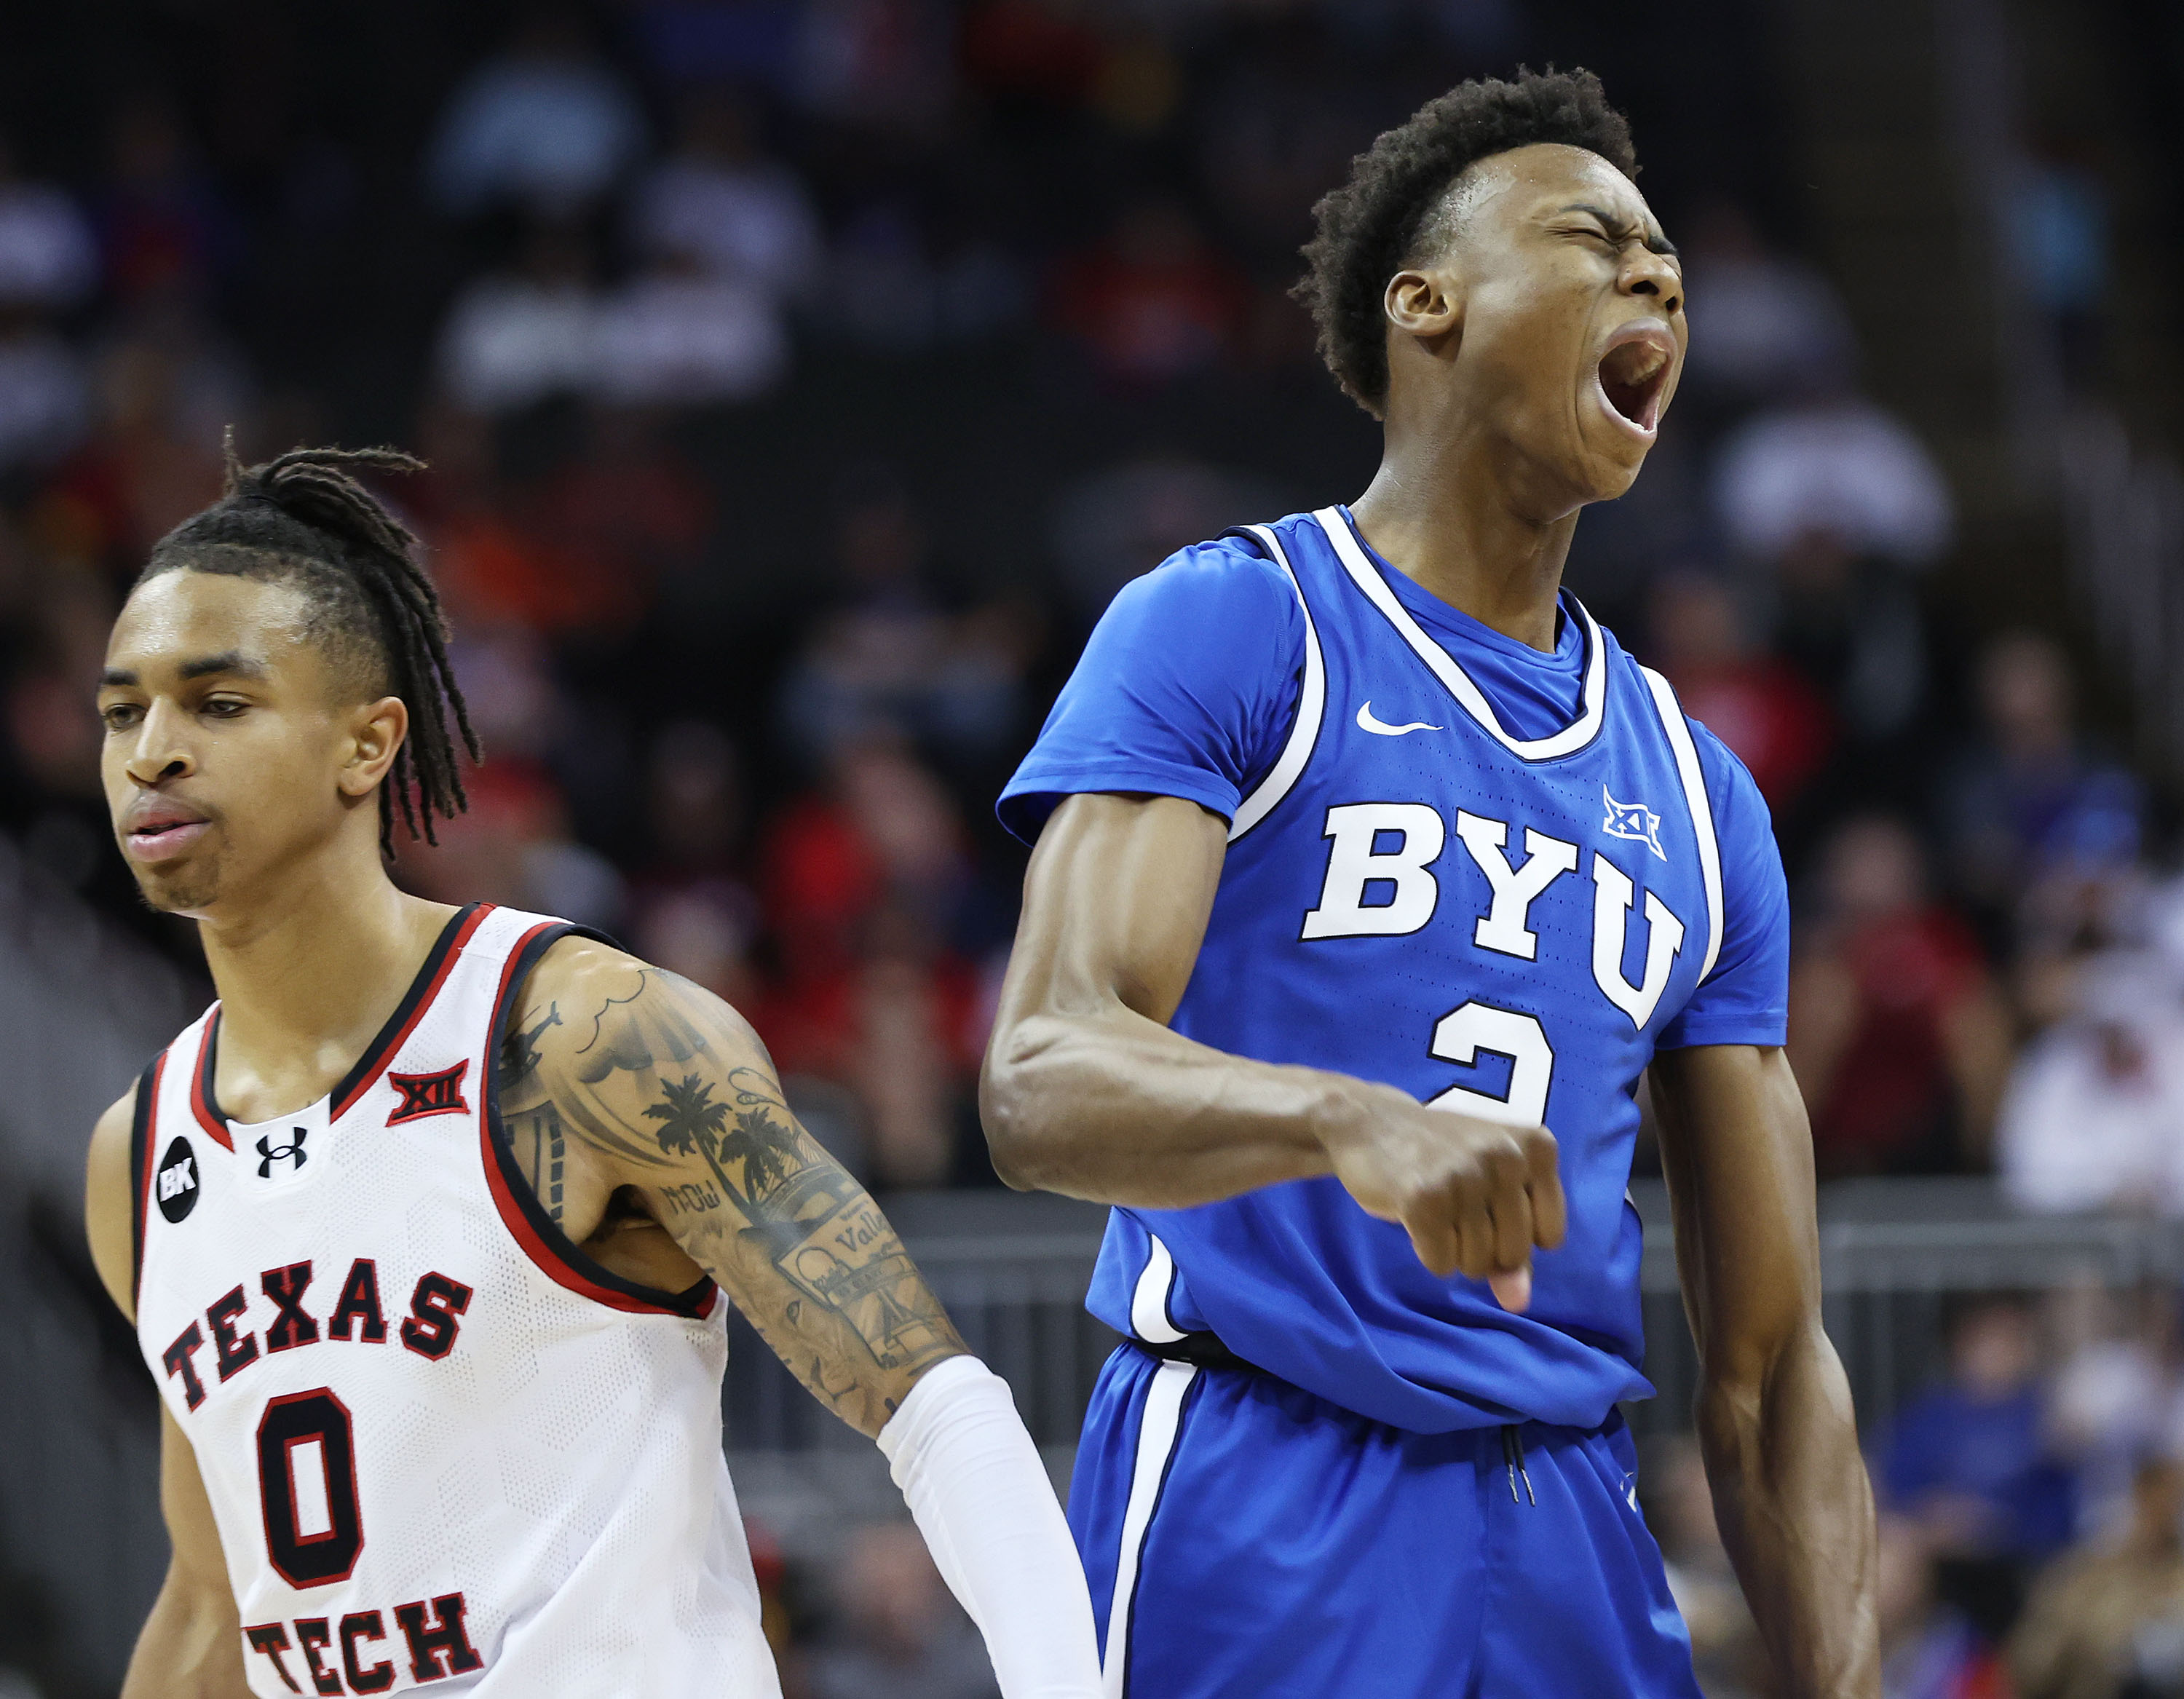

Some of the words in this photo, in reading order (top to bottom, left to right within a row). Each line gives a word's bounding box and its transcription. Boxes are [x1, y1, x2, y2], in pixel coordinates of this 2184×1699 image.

[1299, 802, 1685, 1031] BYU
[387, 1059, 470, 1126] XII
[1425, 998, 1556, 1128] 2
[159, 1157, 197, 1203] BK
[162, 1258, 473, 1413] TEXAS
[257, 1386, 364, 1590] 0
[242, 1591, 484, 1696] TECH
